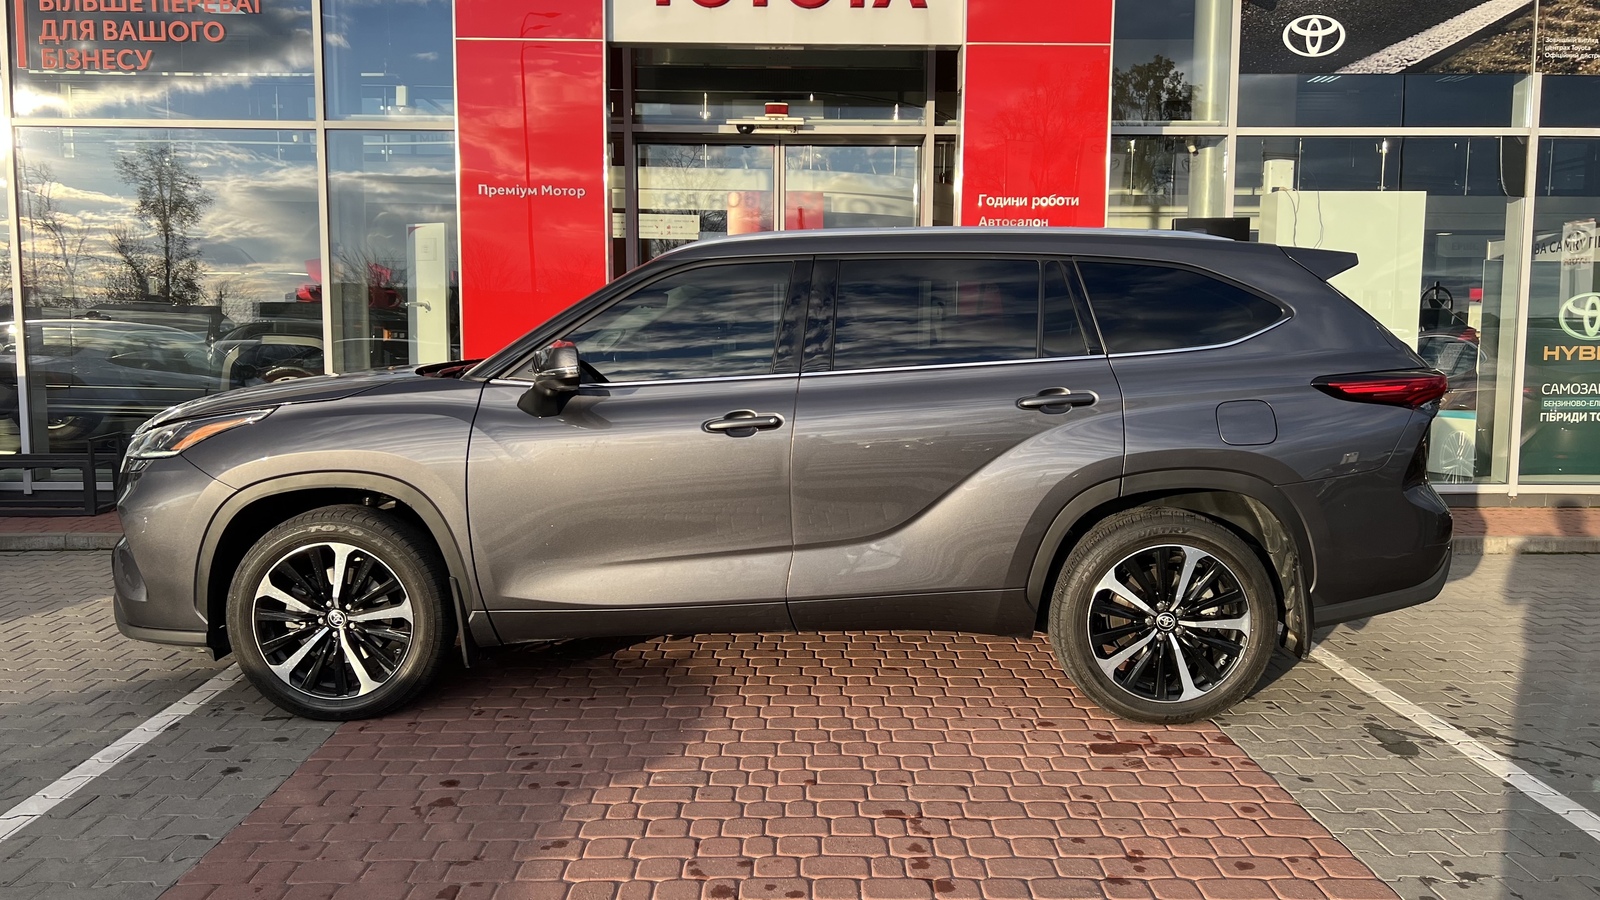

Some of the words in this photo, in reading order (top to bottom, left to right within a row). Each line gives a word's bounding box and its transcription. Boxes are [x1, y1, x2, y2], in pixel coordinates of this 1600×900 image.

[38, 19, 95, 44] ДЛЯ
[103, 20, 226, 42] ВАШОГО
[41, 48, 153, 71] БІЗНЕСУ
[478, 184, 538, 198] Преміум
[541, 185, 586, 199] Мотор
[978, 194, 1028, 208] Години
[1031, 194, 1080, 209] роботи
[979, 216, 1049, 227] Автосалон
[1541, 383, 1600, 395] САМОЗА
[1540, 412, 1588, 423] ГІБРИДИ
[307, 524, 364, 536] TOYO
